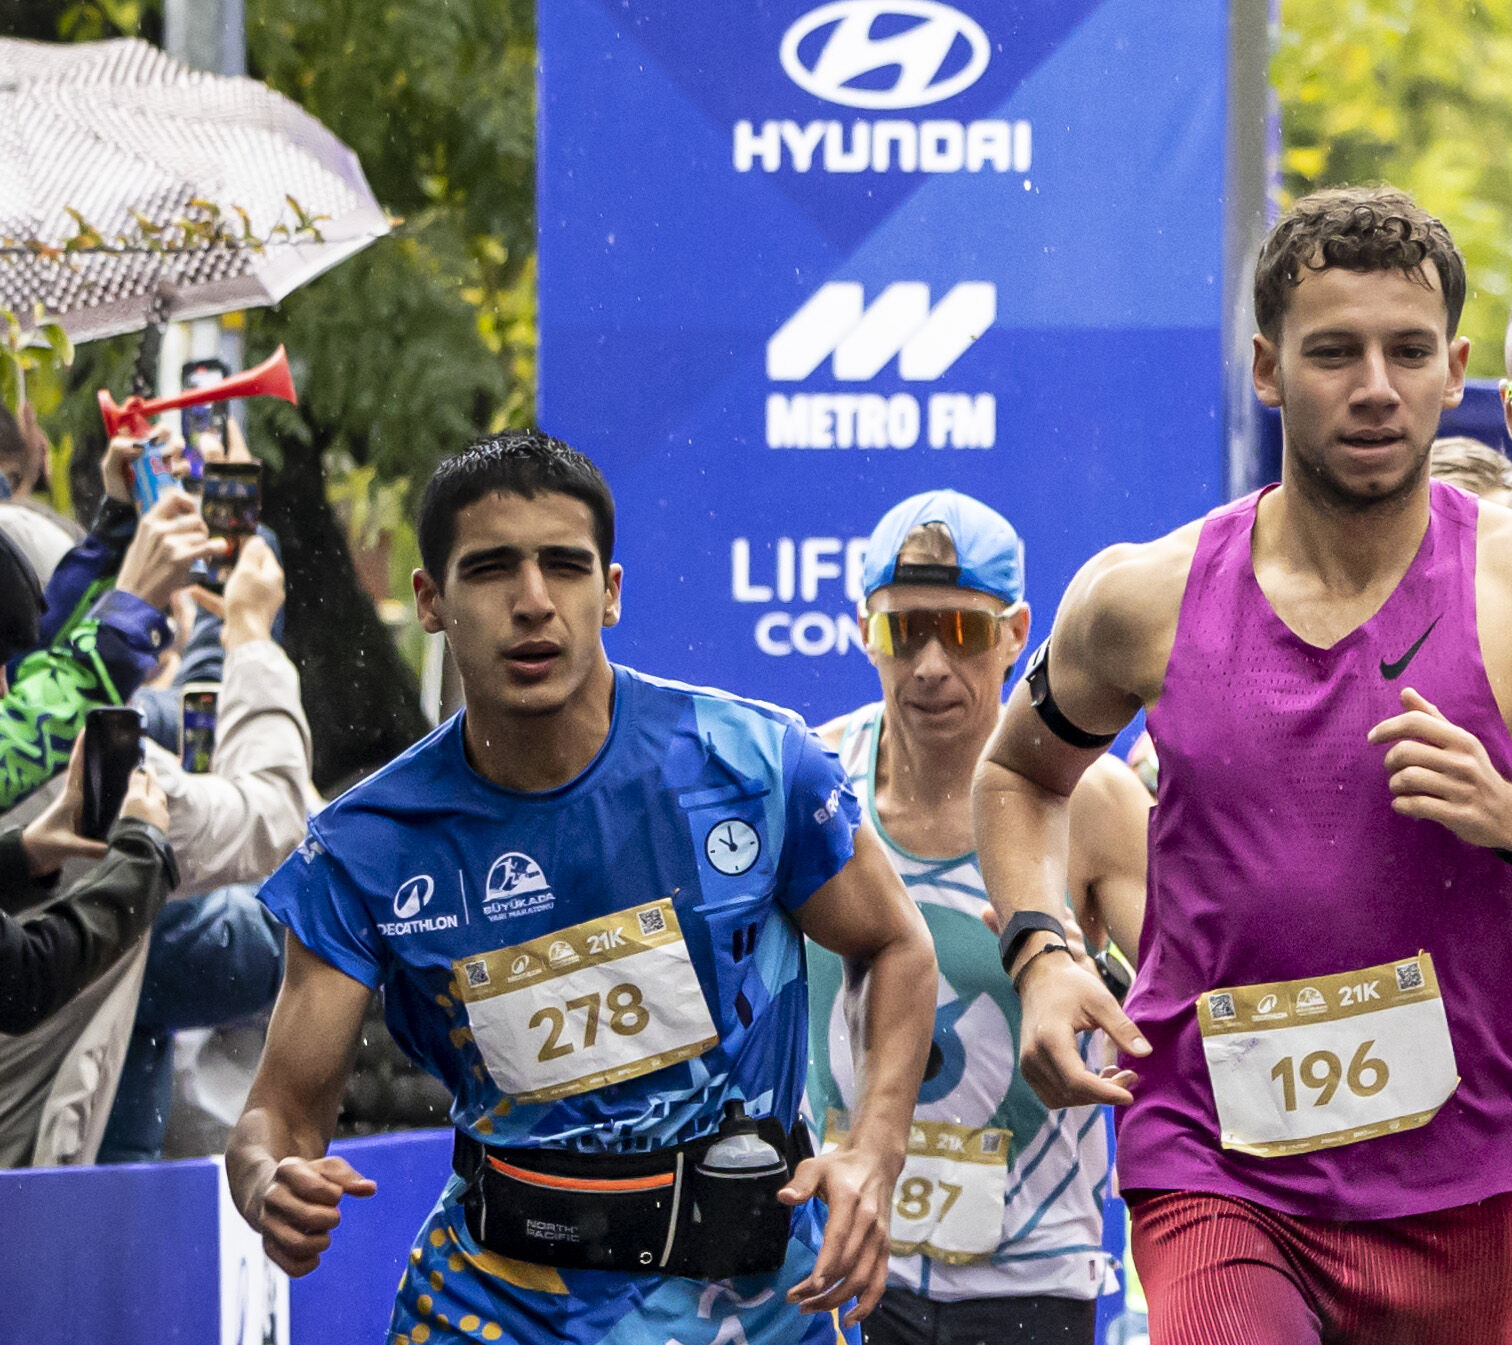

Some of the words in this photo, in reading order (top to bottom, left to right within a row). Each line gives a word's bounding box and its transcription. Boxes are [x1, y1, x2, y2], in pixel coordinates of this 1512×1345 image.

[733, 120, 1032, 173] HYUNDAI
[766, 393, 920, 449] METRO
[928, 393, 996, 449] FM
[482, 891, 556, 916] BÜYÜKADA
[377, 914, 459, 937] DECATHLON
[586, 926, 627, 955] 21K
[1338, 980, 1381, 1007] 21K
[528, 983, 650, 1063] 278
[1271, 1039, 1390, 1113] 196
